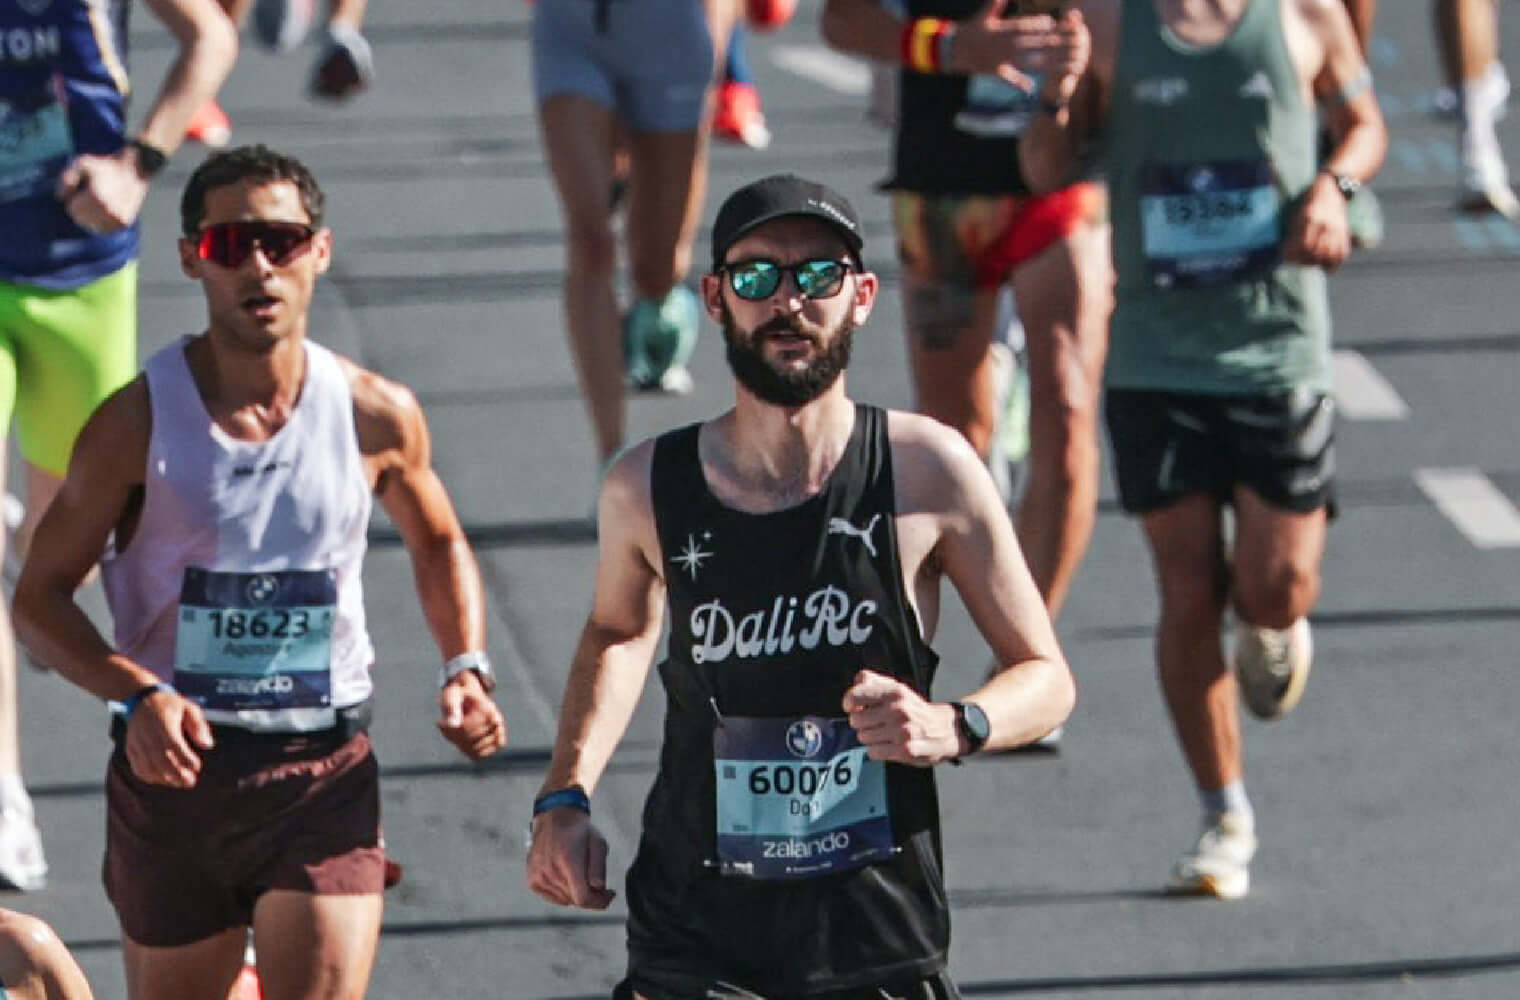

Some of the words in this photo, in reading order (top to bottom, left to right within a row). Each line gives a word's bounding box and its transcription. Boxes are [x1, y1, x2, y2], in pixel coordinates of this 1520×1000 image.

[209, 610, 309, 640] 18623
[748, 756, 852, 795] 60076
[762, 832, 849, 859] zalando
